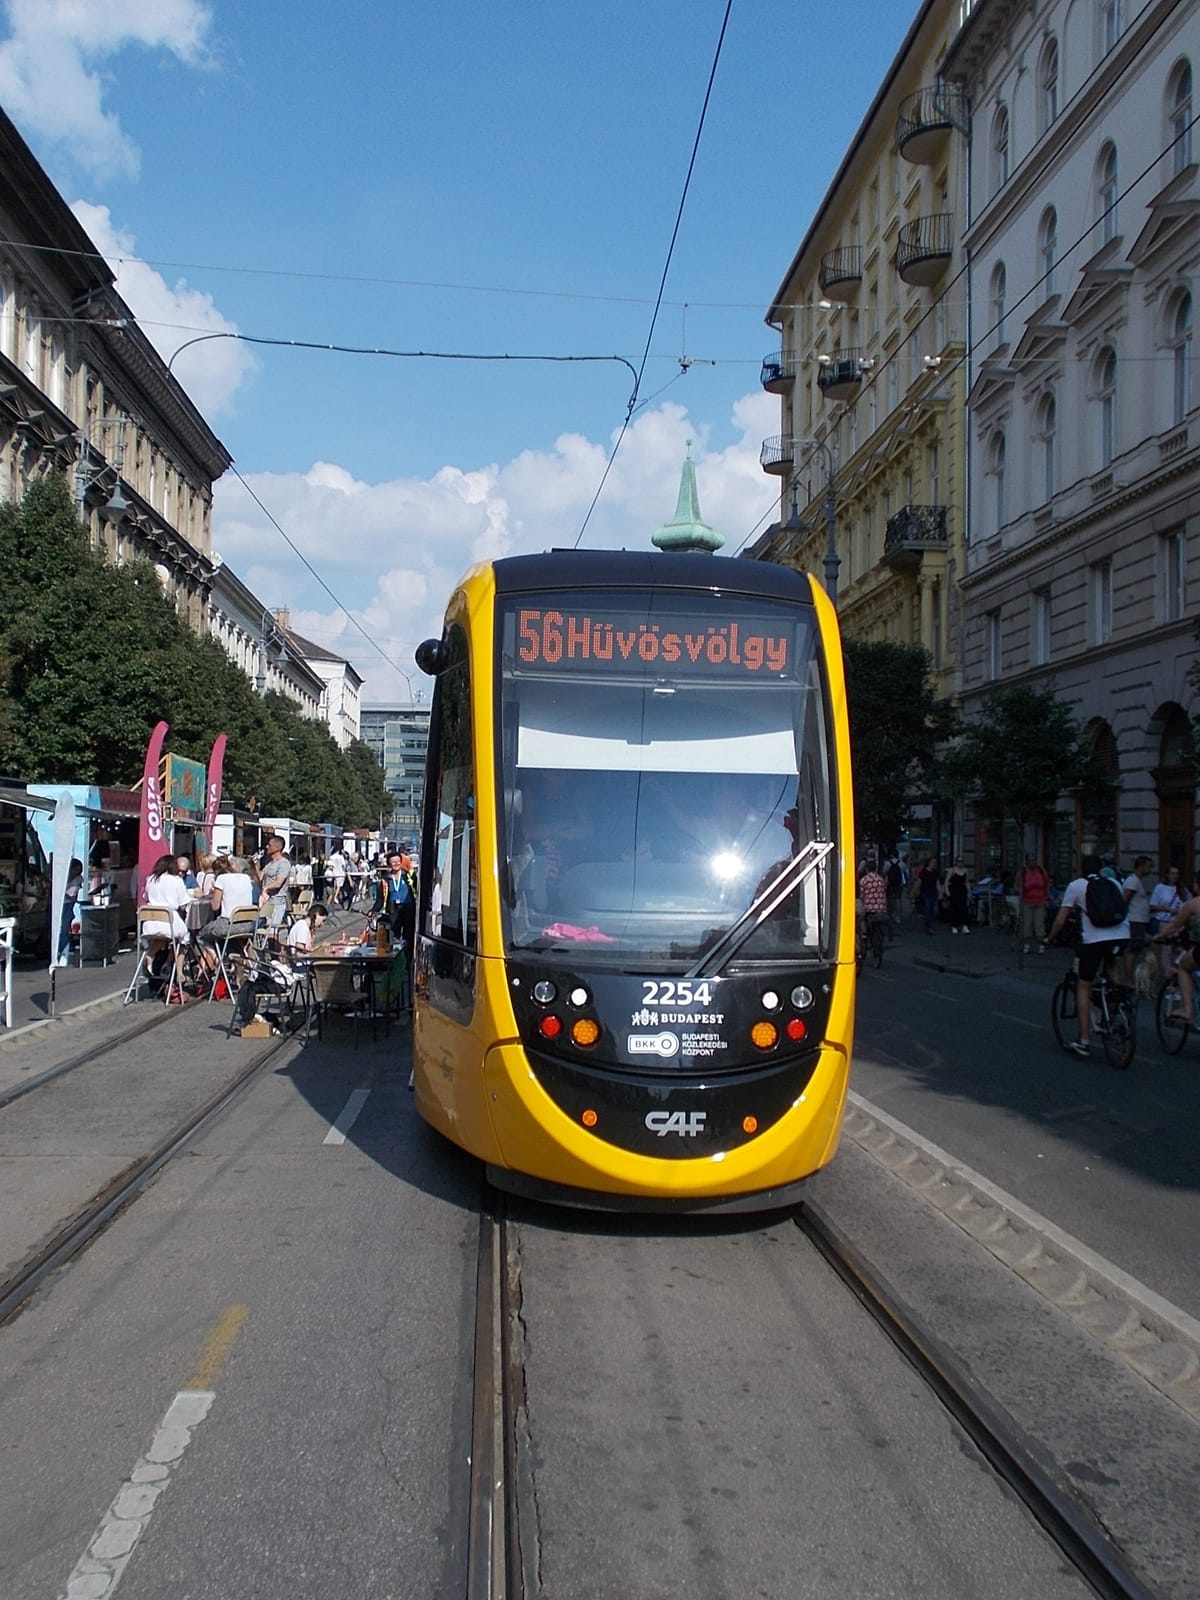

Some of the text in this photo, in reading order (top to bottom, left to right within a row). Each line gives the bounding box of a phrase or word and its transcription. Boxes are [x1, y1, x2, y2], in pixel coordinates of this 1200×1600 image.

[519, 609, 564, 663] 56
[148, 777, 162, 841] COSTA
[642, 981, 712, 1006] 2254
[661, 1013, 724, 1024] BUDAPEST
[635, 1040, 656, 1048] BKK
[682, 1033, 720, 1041] BUDAPESTI
[682, 1048, 715, 1056] KÖZPONT
[645, 1111, 707, 1137] CAF
